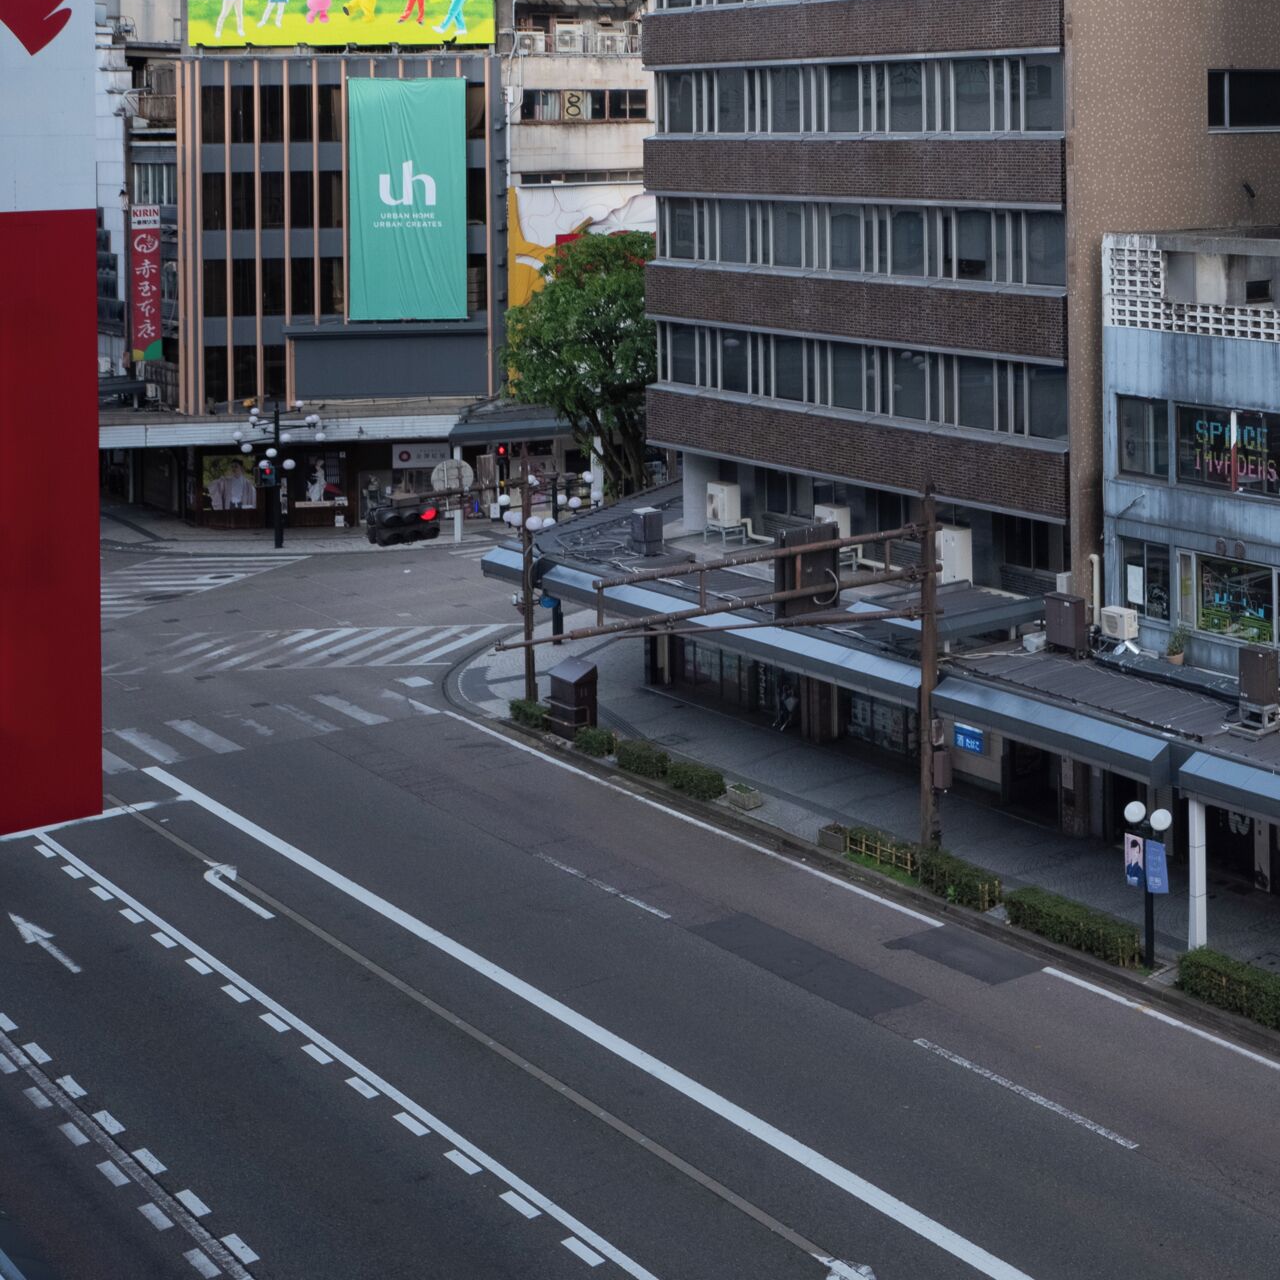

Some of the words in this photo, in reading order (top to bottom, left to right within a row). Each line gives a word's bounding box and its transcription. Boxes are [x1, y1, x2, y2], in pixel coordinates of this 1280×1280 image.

[379, 160, 436, 206] uh
[132, 208, 159, 218] KIRIN
[1195, 420, 1269, 453] SPACE
